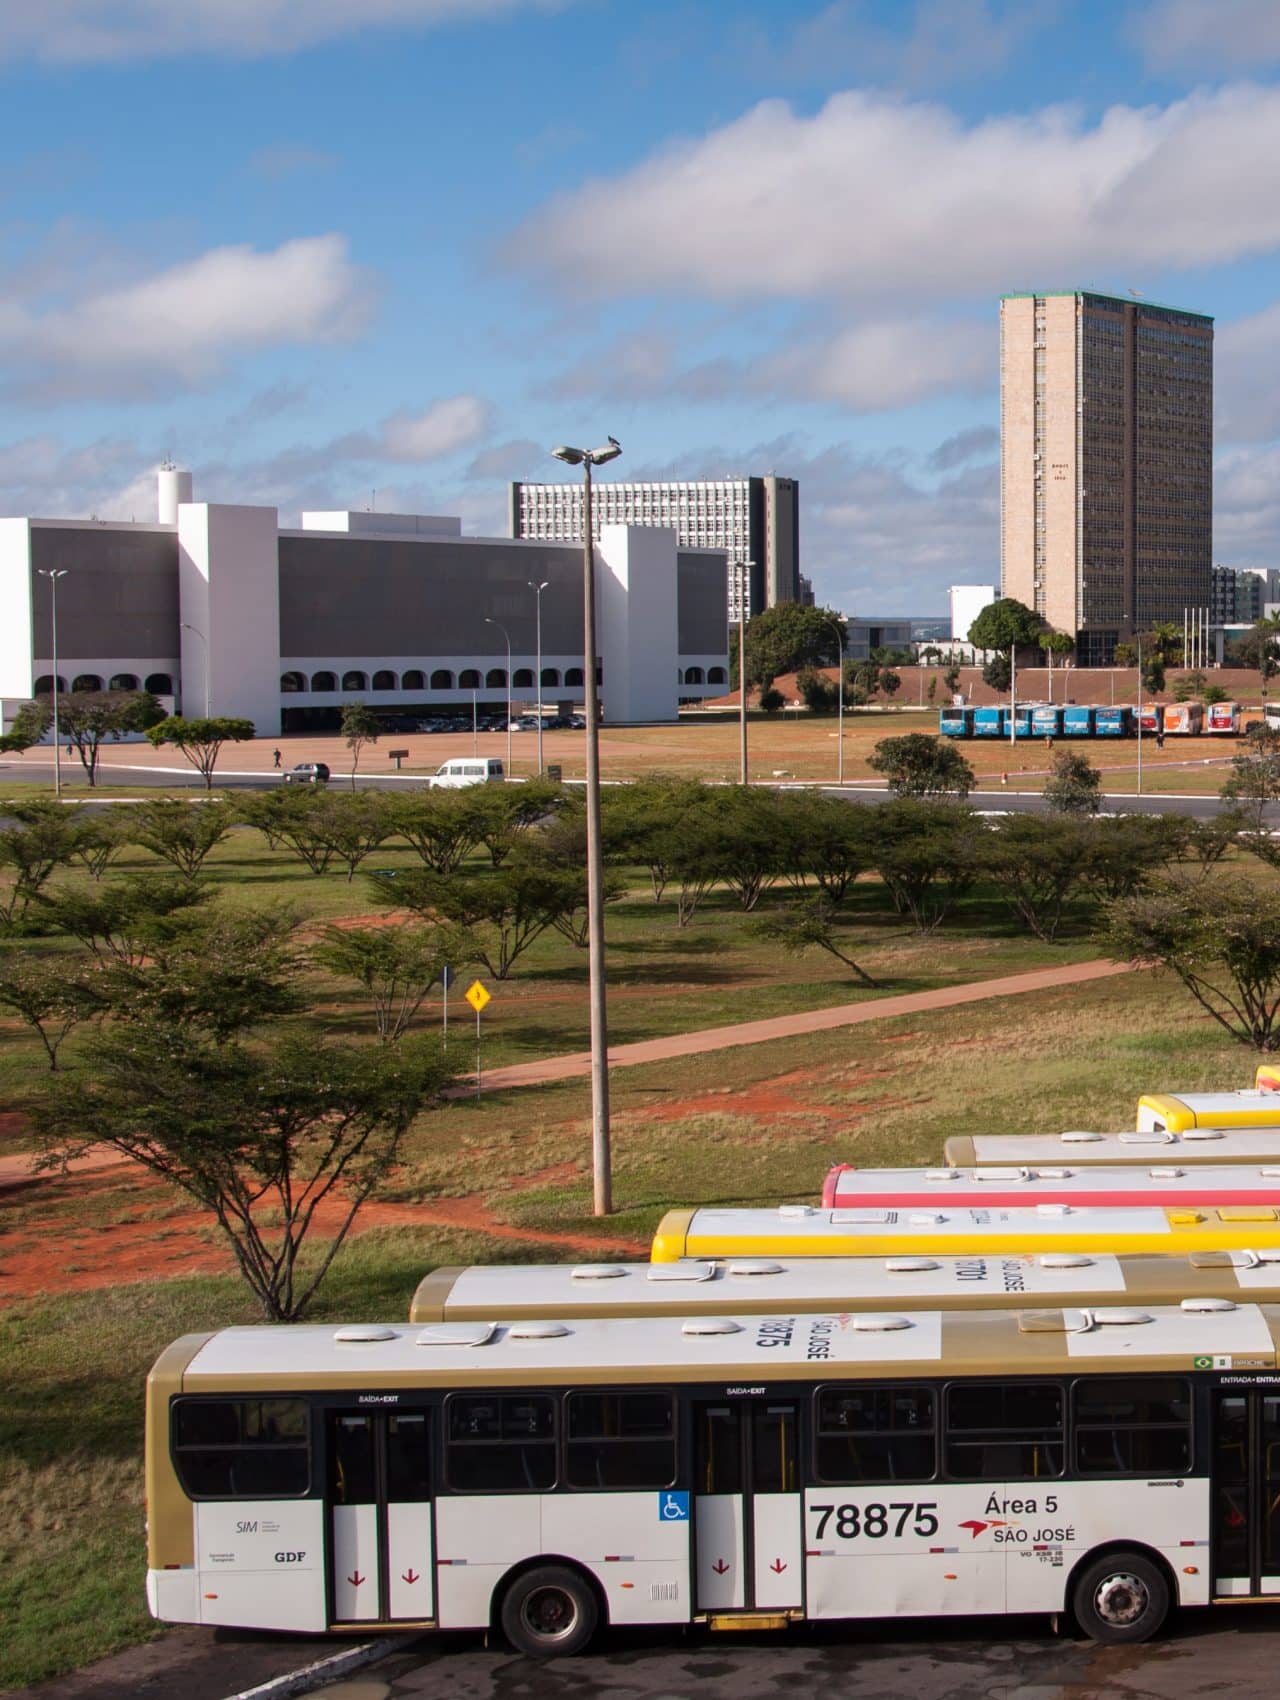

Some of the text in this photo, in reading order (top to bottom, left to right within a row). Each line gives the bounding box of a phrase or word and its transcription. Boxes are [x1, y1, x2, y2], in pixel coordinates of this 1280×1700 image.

[806, 1335, 836, 1360] JOSÉ
[1220, 1376, 1252, 1384] ENTRADA
[750, 1387, 767, 1395] EXIT
[984, 1490, 1059, 1515] Área 5
[235, 1520, 258, 1534] SIM
[809, 1502, 939, 1540] 78875
[993, 1524, 1076, 1543] SÃO JOSÉ
[274, 1551, 306, 1563] GDF
